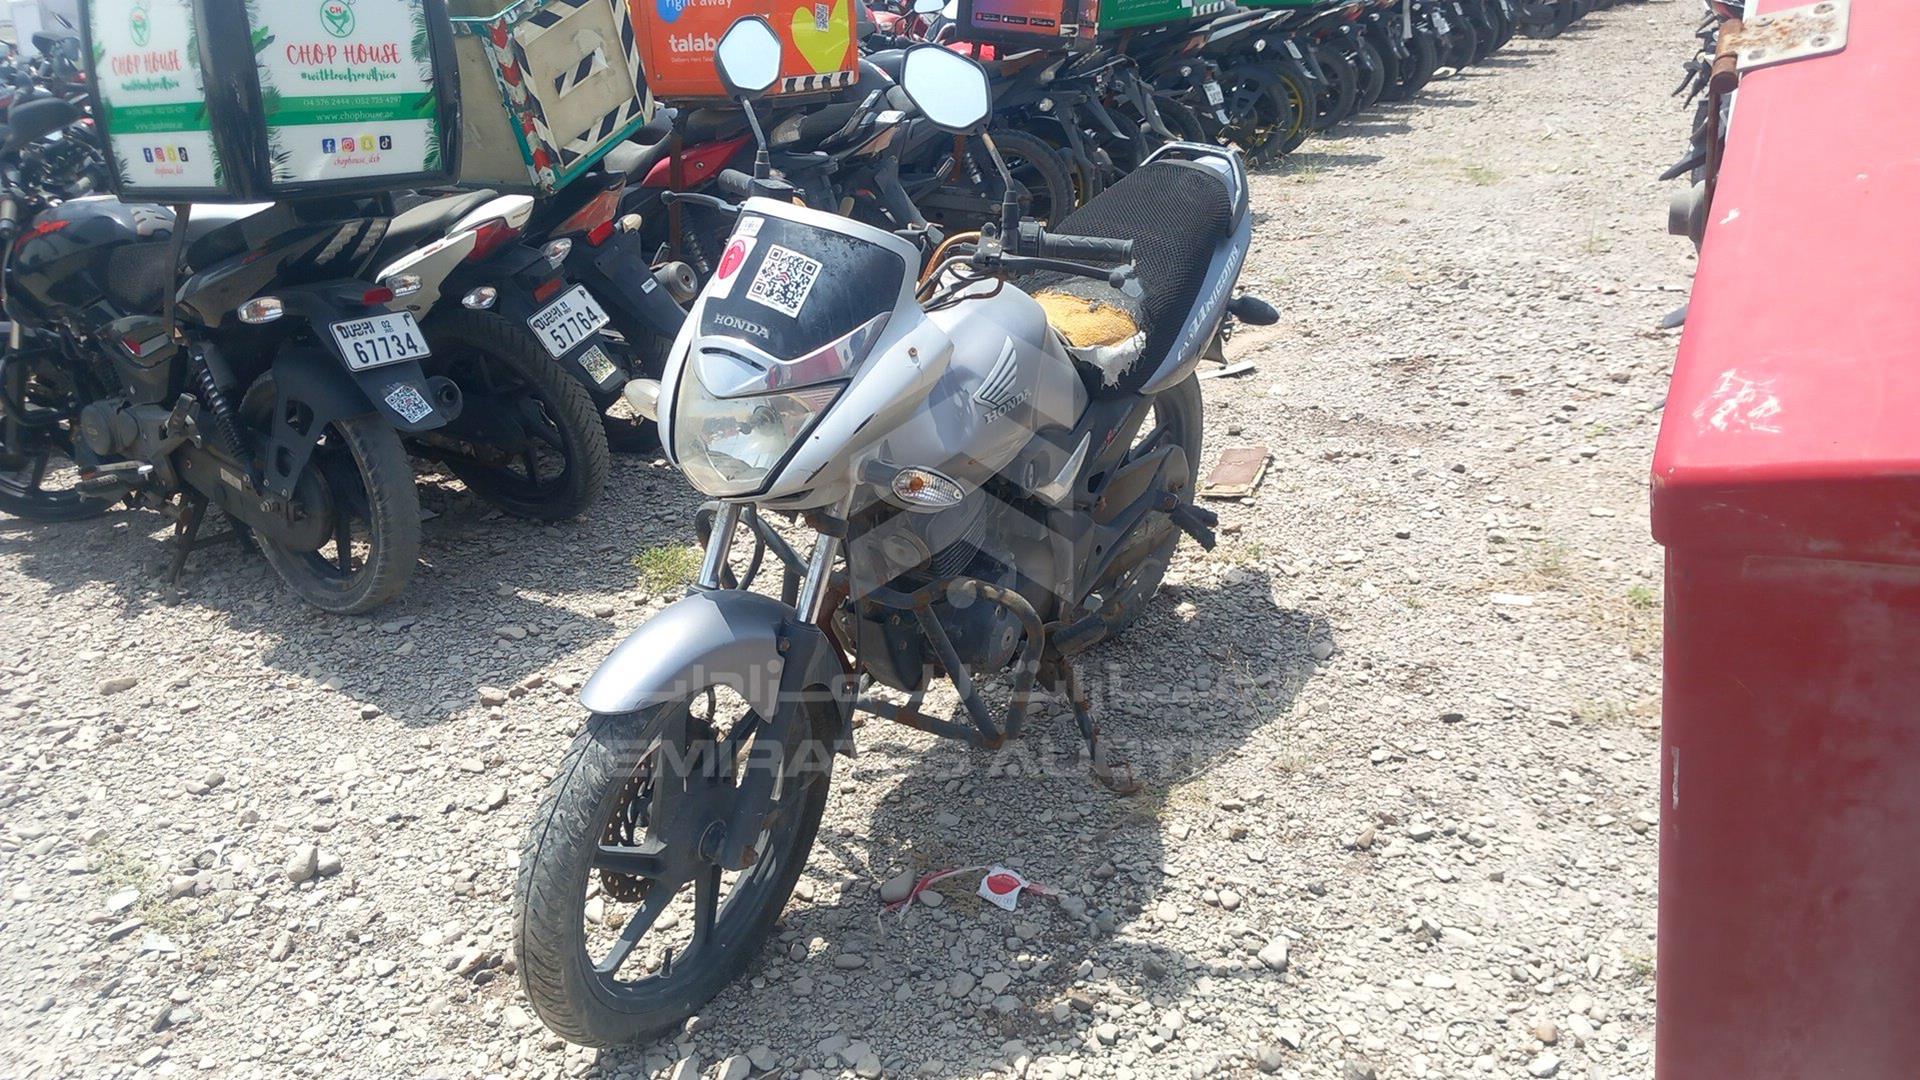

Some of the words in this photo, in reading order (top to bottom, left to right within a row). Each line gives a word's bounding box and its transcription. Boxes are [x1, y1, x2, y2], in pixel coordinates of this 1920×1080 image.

[329, 6, 343, 14] CH
[287, 43, 337, 66] CHOP
[343, 42, 401, 66] HOUSE
[668, 32, 718, 52] talab
[112, 54, 141, 76] CHOP
[144, 48, 182, 74] HOUSE
[381, 320, 391, 329] 02
[550, 305, 600, 349] 57764
[714, 314, 769, 340] HONDA
[353, 333, 418, 364] 67734
[984, 388, 1032, 425] HONDA
